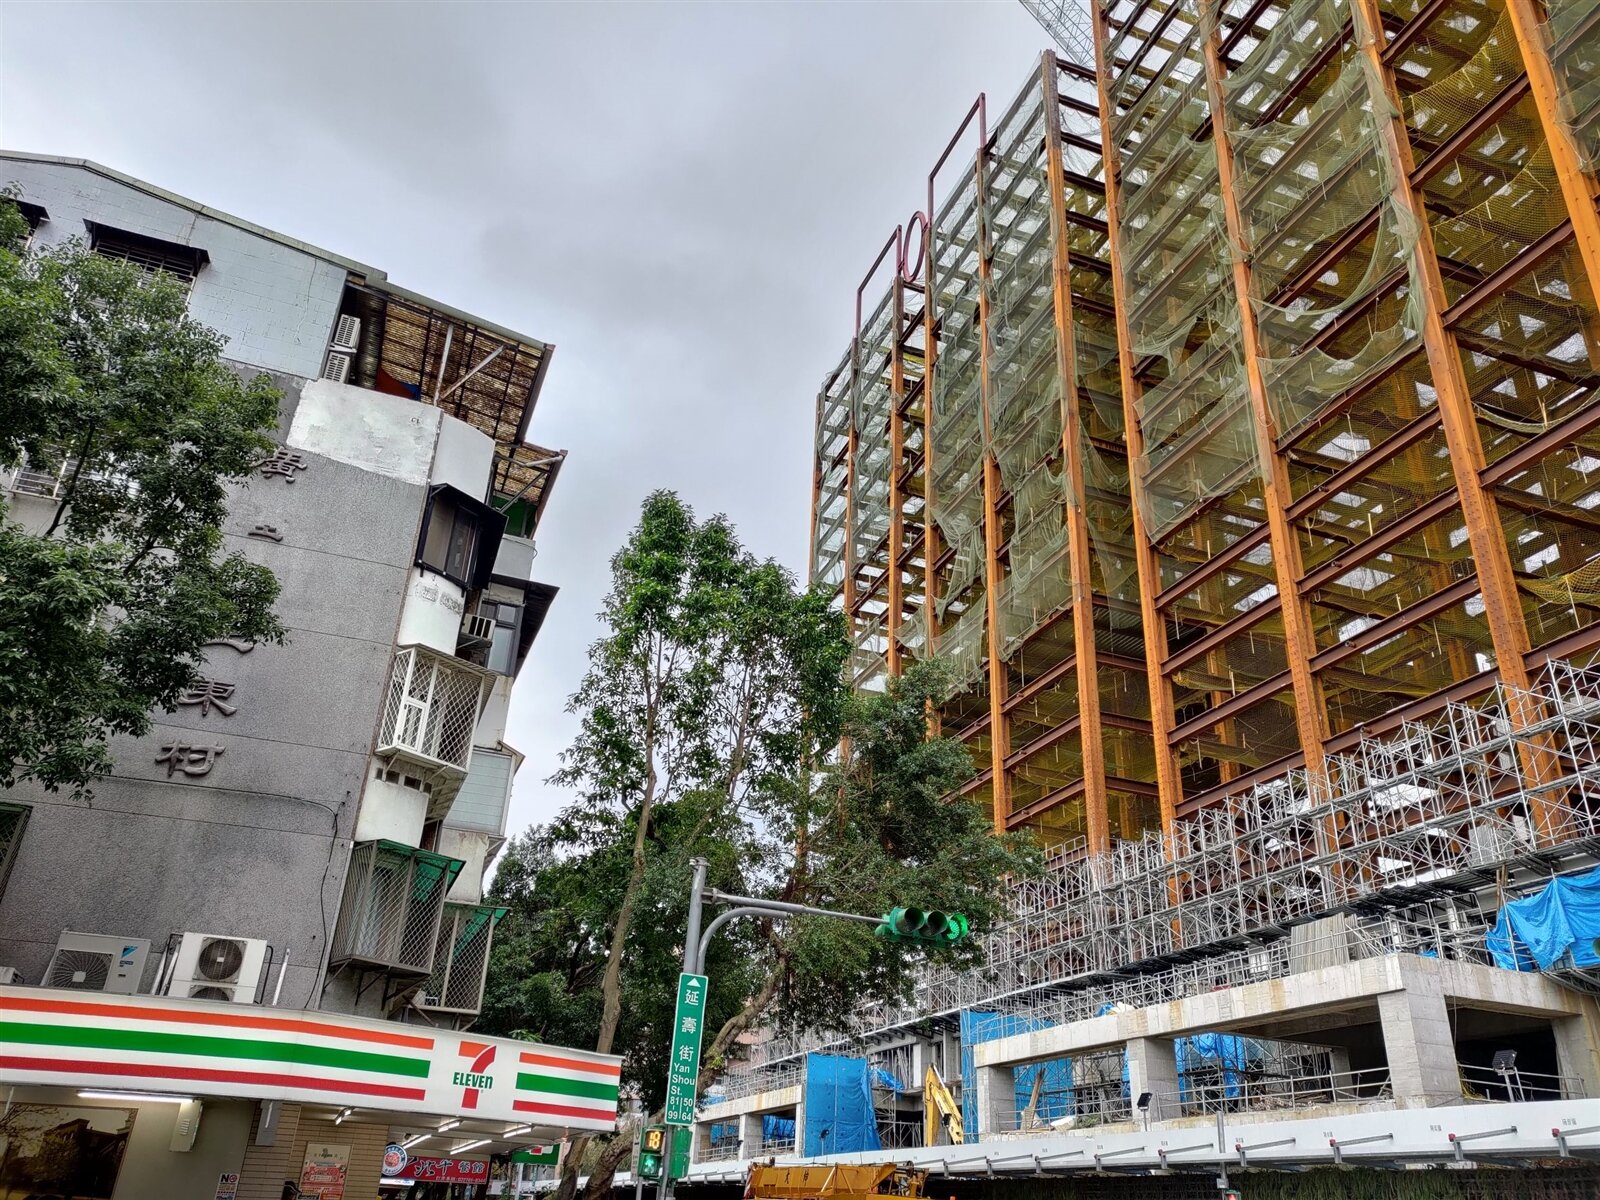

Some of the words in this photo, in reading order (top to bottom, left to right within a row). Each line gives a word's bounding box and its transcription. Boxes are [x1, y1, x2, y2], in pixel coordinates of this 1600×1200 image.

[679, 989, 700, 1062] 延壽街
[674, 1063, 690, 1073] Yan
[458, 1041, 497, 1109] 7
[672, 1074, 695, 1086] Shou
[671, 1086, 682, 1096] St.
[670, 1096, 679, 1105] 81
[683, 1097, 693, 1107] 50
[668, 1110, 678, 1120] 99
[682, 1111, 692, 1121] 64
[649, 1131, 661, 1149] 18
